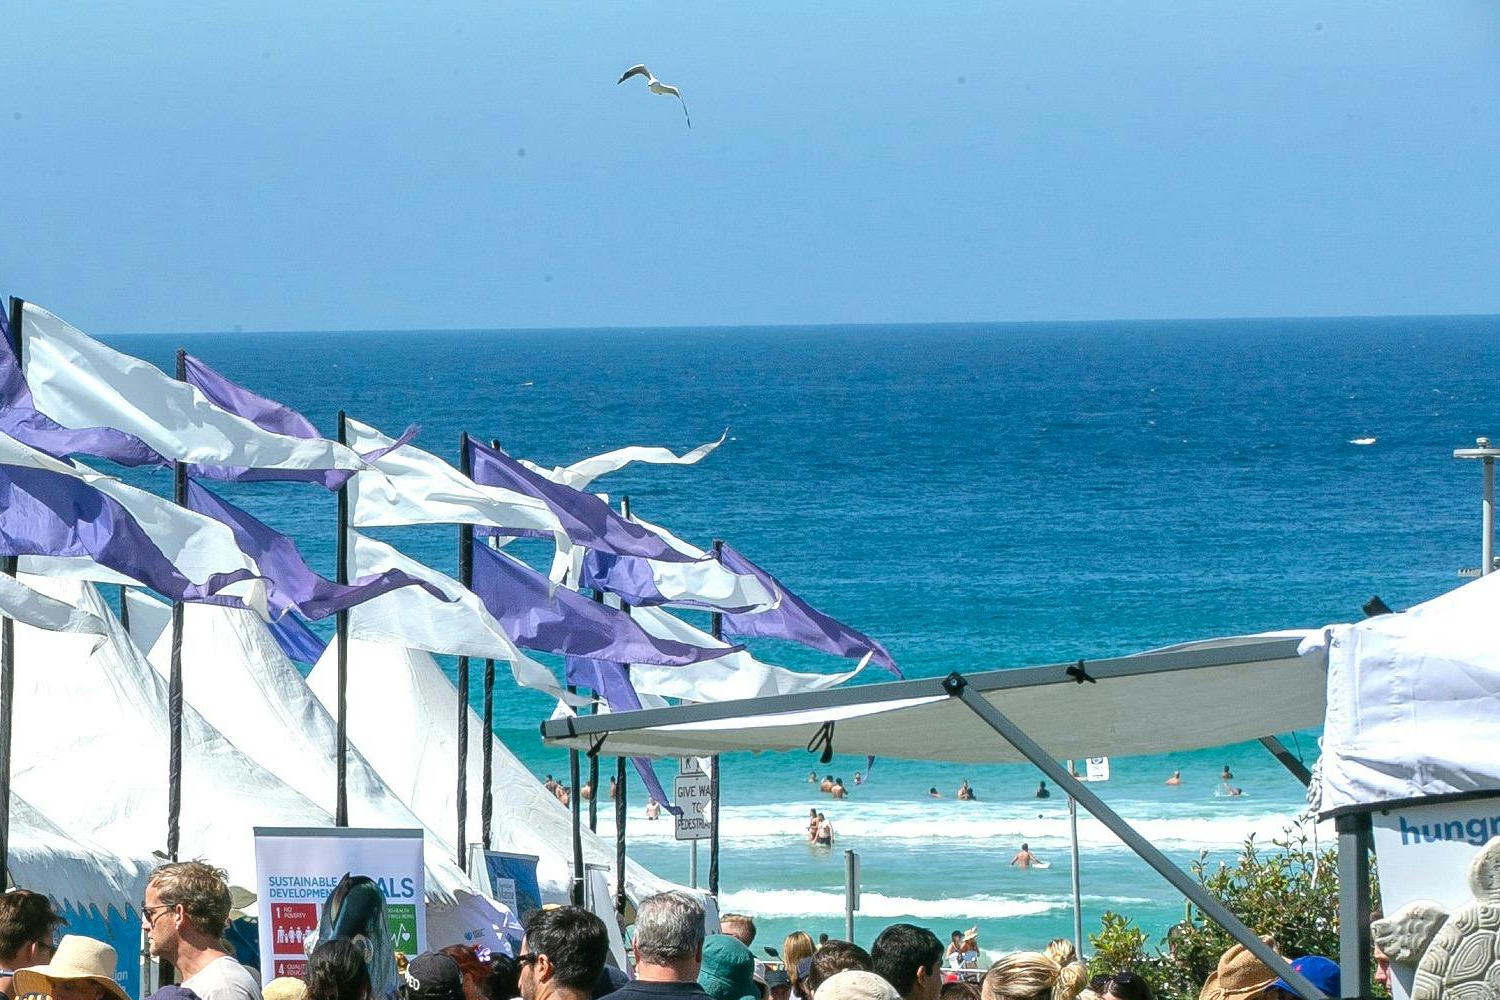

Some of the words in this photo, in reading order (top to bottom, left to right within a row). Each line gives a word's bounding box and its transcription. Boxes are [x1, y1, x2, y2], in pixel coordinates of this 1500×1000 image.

[677, 786, 696, 798] GIVE
[699, 785, 713, 796] WA
[677, 818, 711, 830] PEDESTRIA
[268, 876, 337, 887] SUSTAINABLE
[378, 877, 415, 898] ALS
[269, 888, 334, 898] DEVELOPMEN
